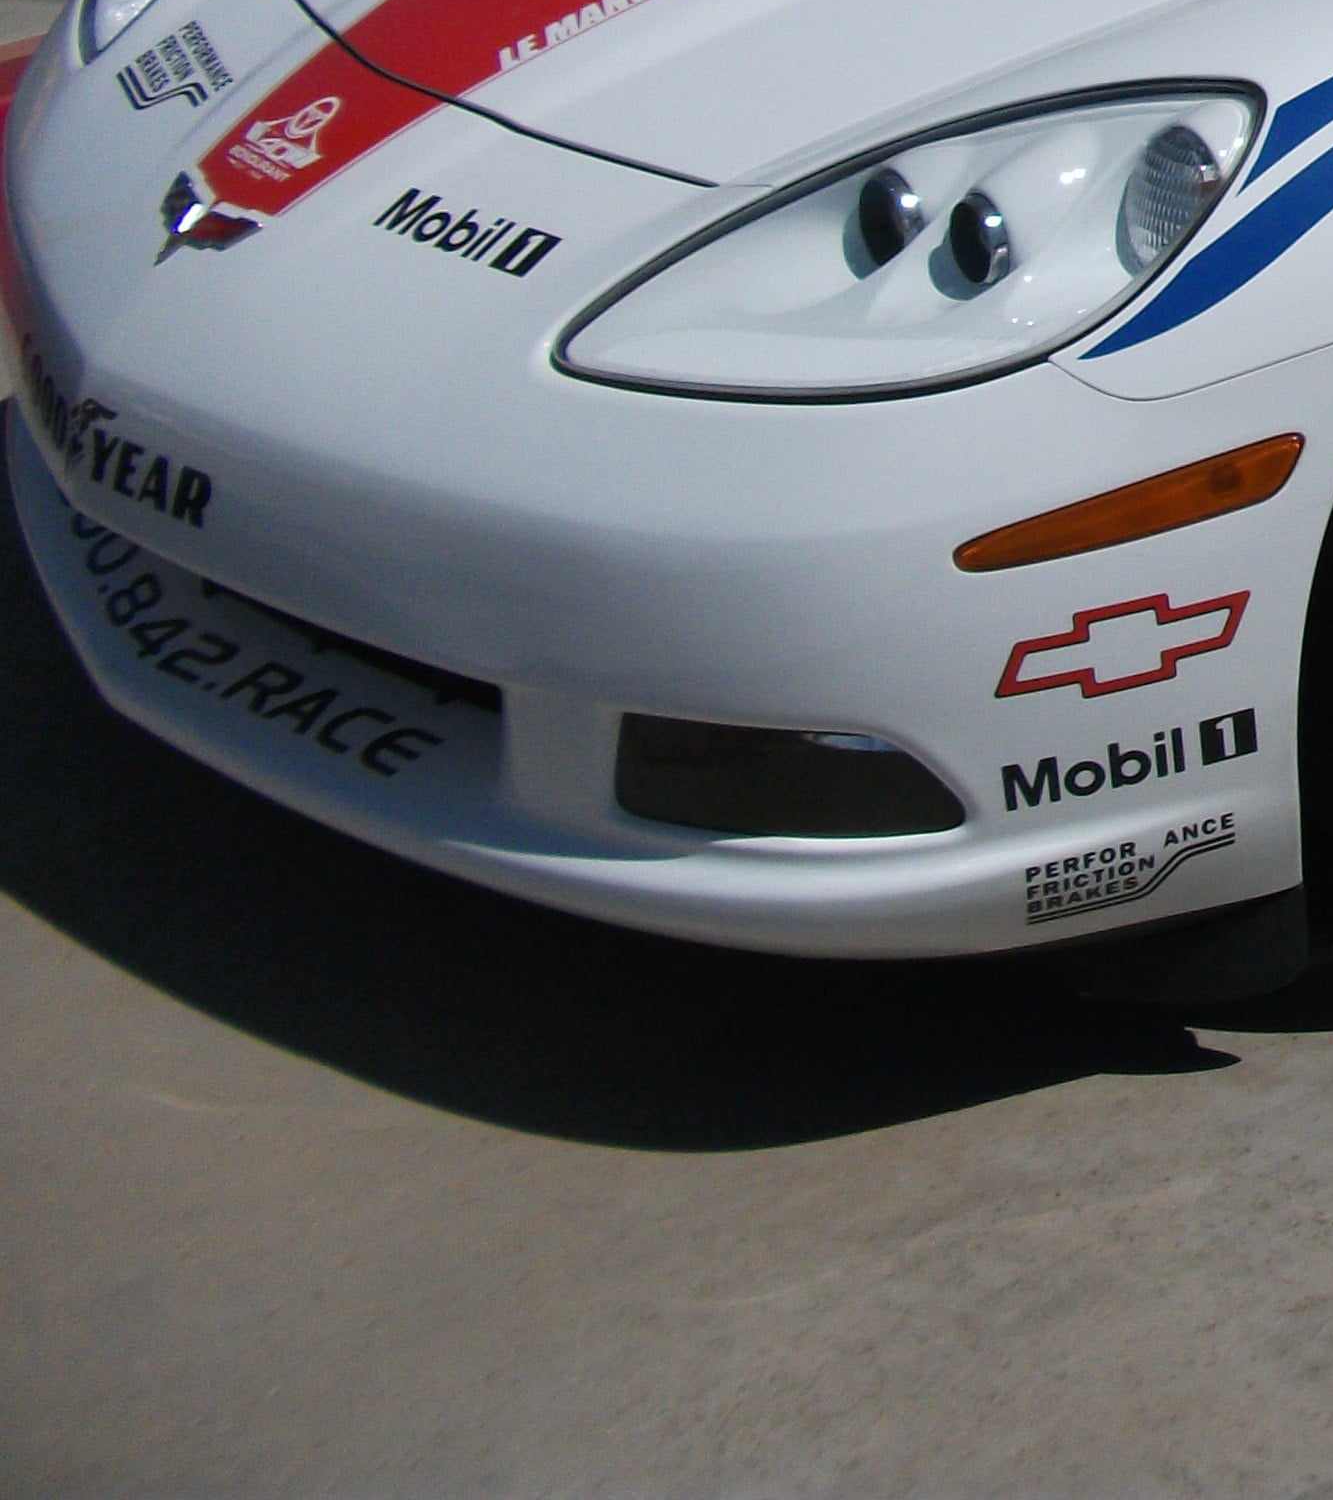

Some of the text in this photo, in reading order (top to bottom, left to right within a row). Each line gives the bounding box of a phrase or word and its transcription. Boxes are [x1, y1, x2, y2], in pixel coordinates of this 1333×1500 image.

[498, 34, 543, 72] LE
[372, 188, 516, 262] Mobil
[1002, 728, 1185, 812] Mobil
[1027, 854, 1155, 901] FRICTION
[1027, 876, 1139, 914] BRAKES
